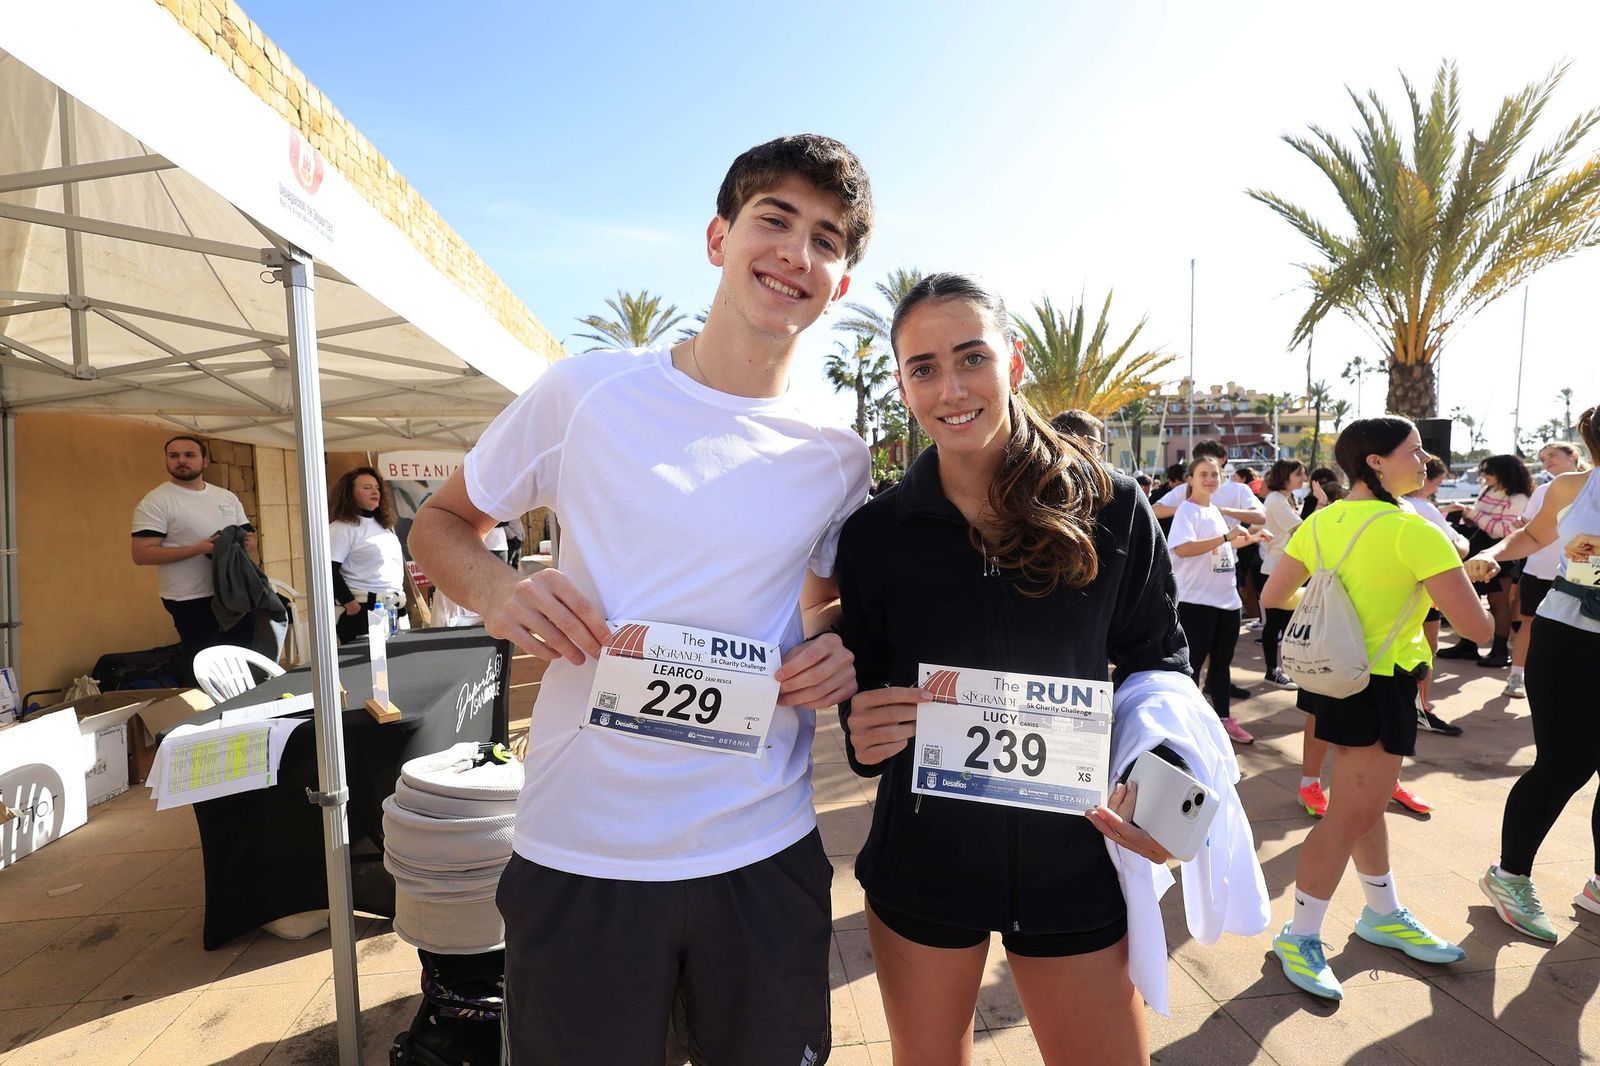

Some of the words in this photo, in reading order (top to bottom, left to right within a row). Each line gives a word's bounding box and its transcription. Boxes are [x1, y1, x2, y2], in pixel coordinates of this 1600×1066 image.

[682, 632, 706, 647] The
[710, 636, 767, 664] RUN
[653, 664, 704, 680] LEARCO
[719, 659, 739, 668] Charity
[740, 662, 767, 672] Challenge
[994, 677, 1020, 693] The
[1026, 680, 1093, 708] RUN
[639, 680, 722, 725] 229
[1035, 704, 1060, 713] Charity
[1060, 707, 1092, 716] Challenge
[983, 711, 1018, 725] LUCY
[746, 722, 752, 730] L
[718, 737, 751, 747] BETANIA
[964, 725, 1047, 777] 239
[1077, 772, 1091, 783] XS
[1053, 794, 1091, 805] BETANIA
